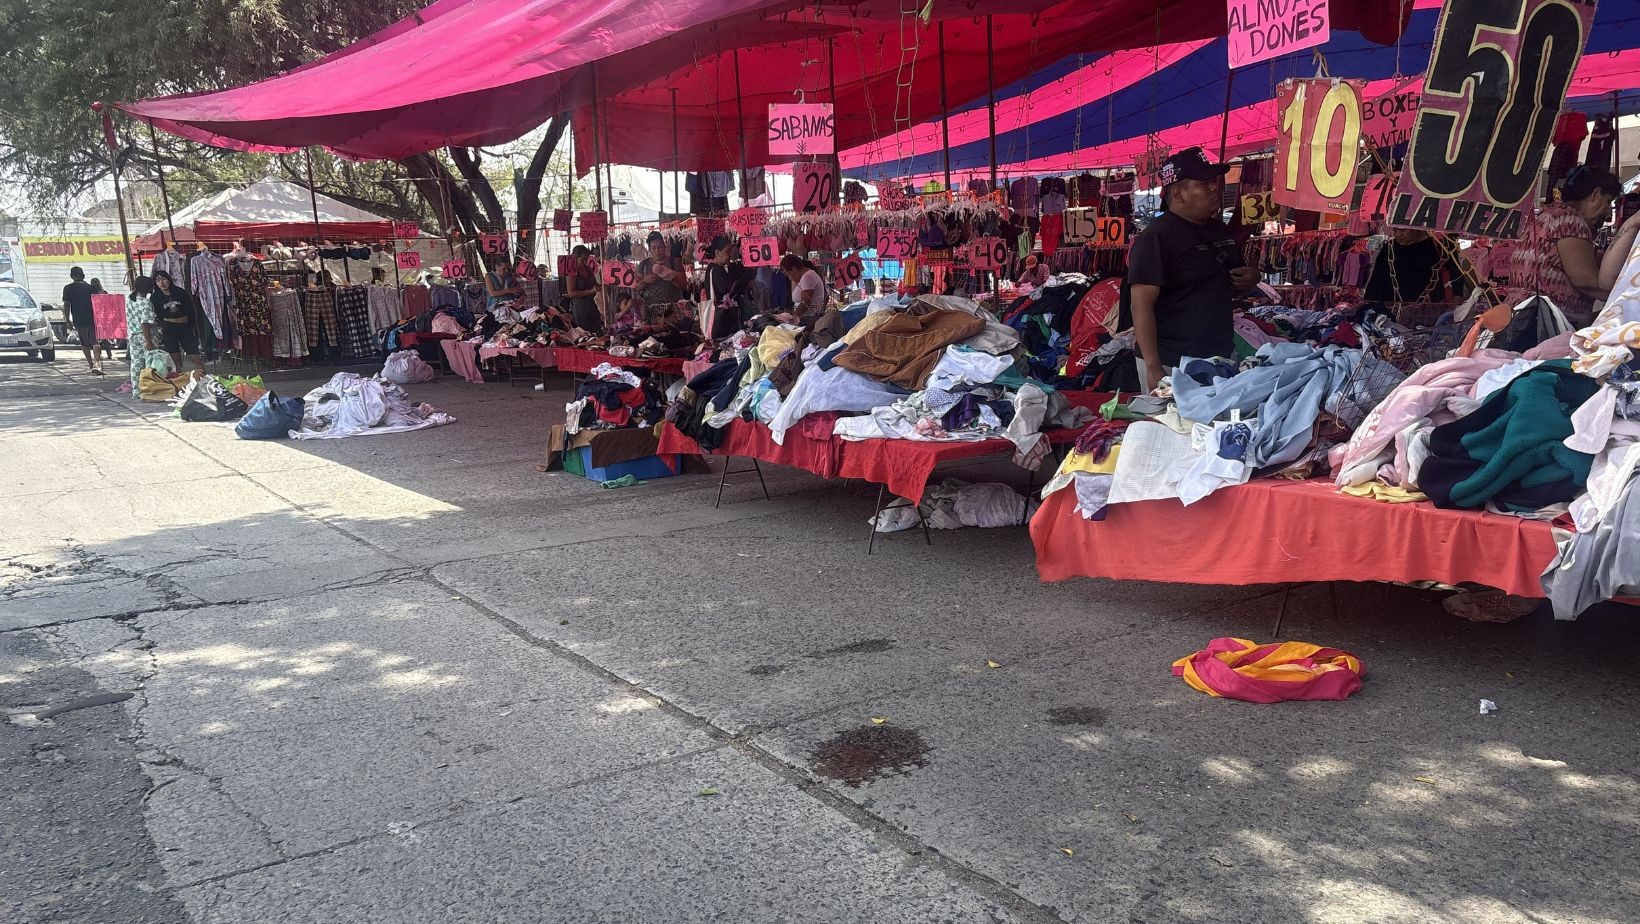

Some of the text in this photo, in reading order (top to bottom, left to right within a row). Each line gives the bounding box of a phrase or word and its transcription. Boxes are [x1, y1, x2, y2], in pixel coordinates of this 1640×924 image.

[1250, 2, 1326, 57] DONES
[1408, 0, 1584, 208] 50
[769, 114, 834, 141] SABANAS
[1389, 116, 1398, 128] Y
[1283, 80, 1361, 199] 10
[802, 172, 833, 213] 20
[1391, 193, 1441, 229] LA
[1445, 199, 1522, 239] PIEZA
[487, 239, 507, 254] 50
[748, 244, 772, 263] 50
[974, 241, 1007, 268] 40
[401, 256, 417, 267] 40
[443, 264, 467, 279] 100
[609, 267, 635, 287] 50
